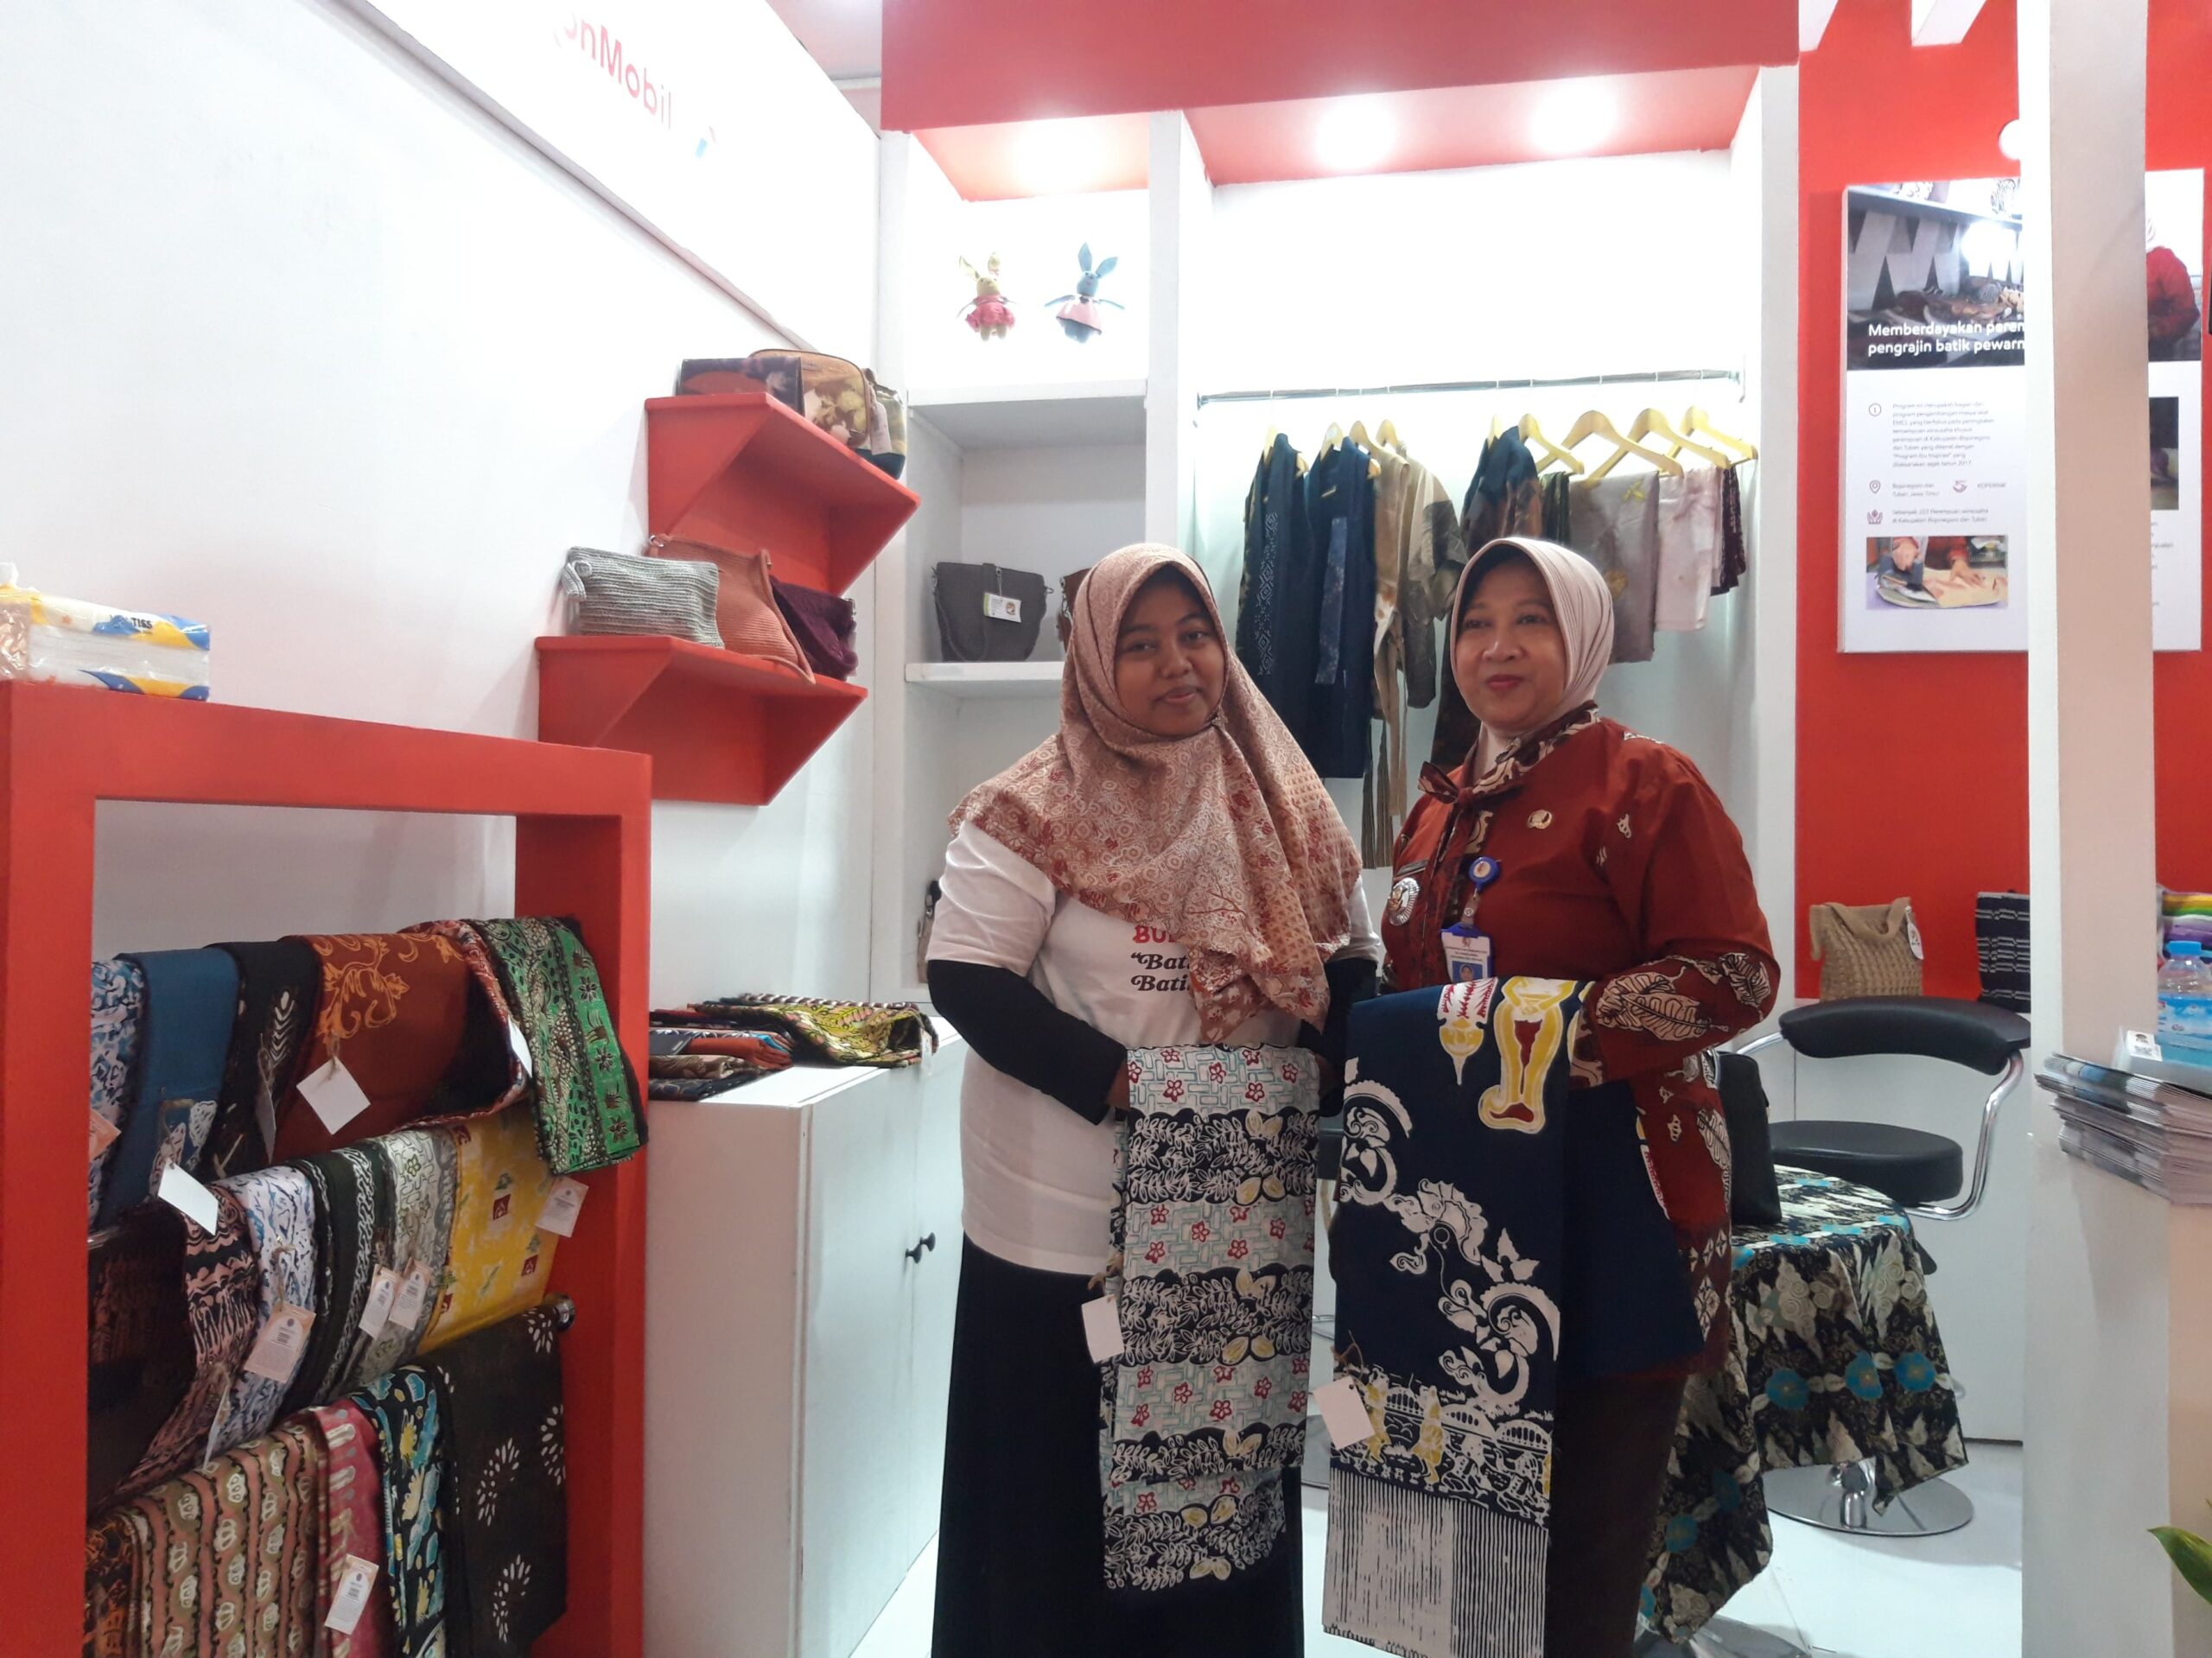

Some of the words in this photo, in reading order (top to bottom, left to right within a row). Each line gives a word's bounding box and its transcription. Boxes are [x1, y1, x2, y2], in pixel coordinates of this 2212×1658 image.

[553, 9, 671, 130] nMobil
[1868, 321, 1982, 337] Memberdayakan
[1868, 339, 1932, 357] pengrajin
[1936, 338, 1970, 353] batik
[1130, 974, 1190, 992] Bati
